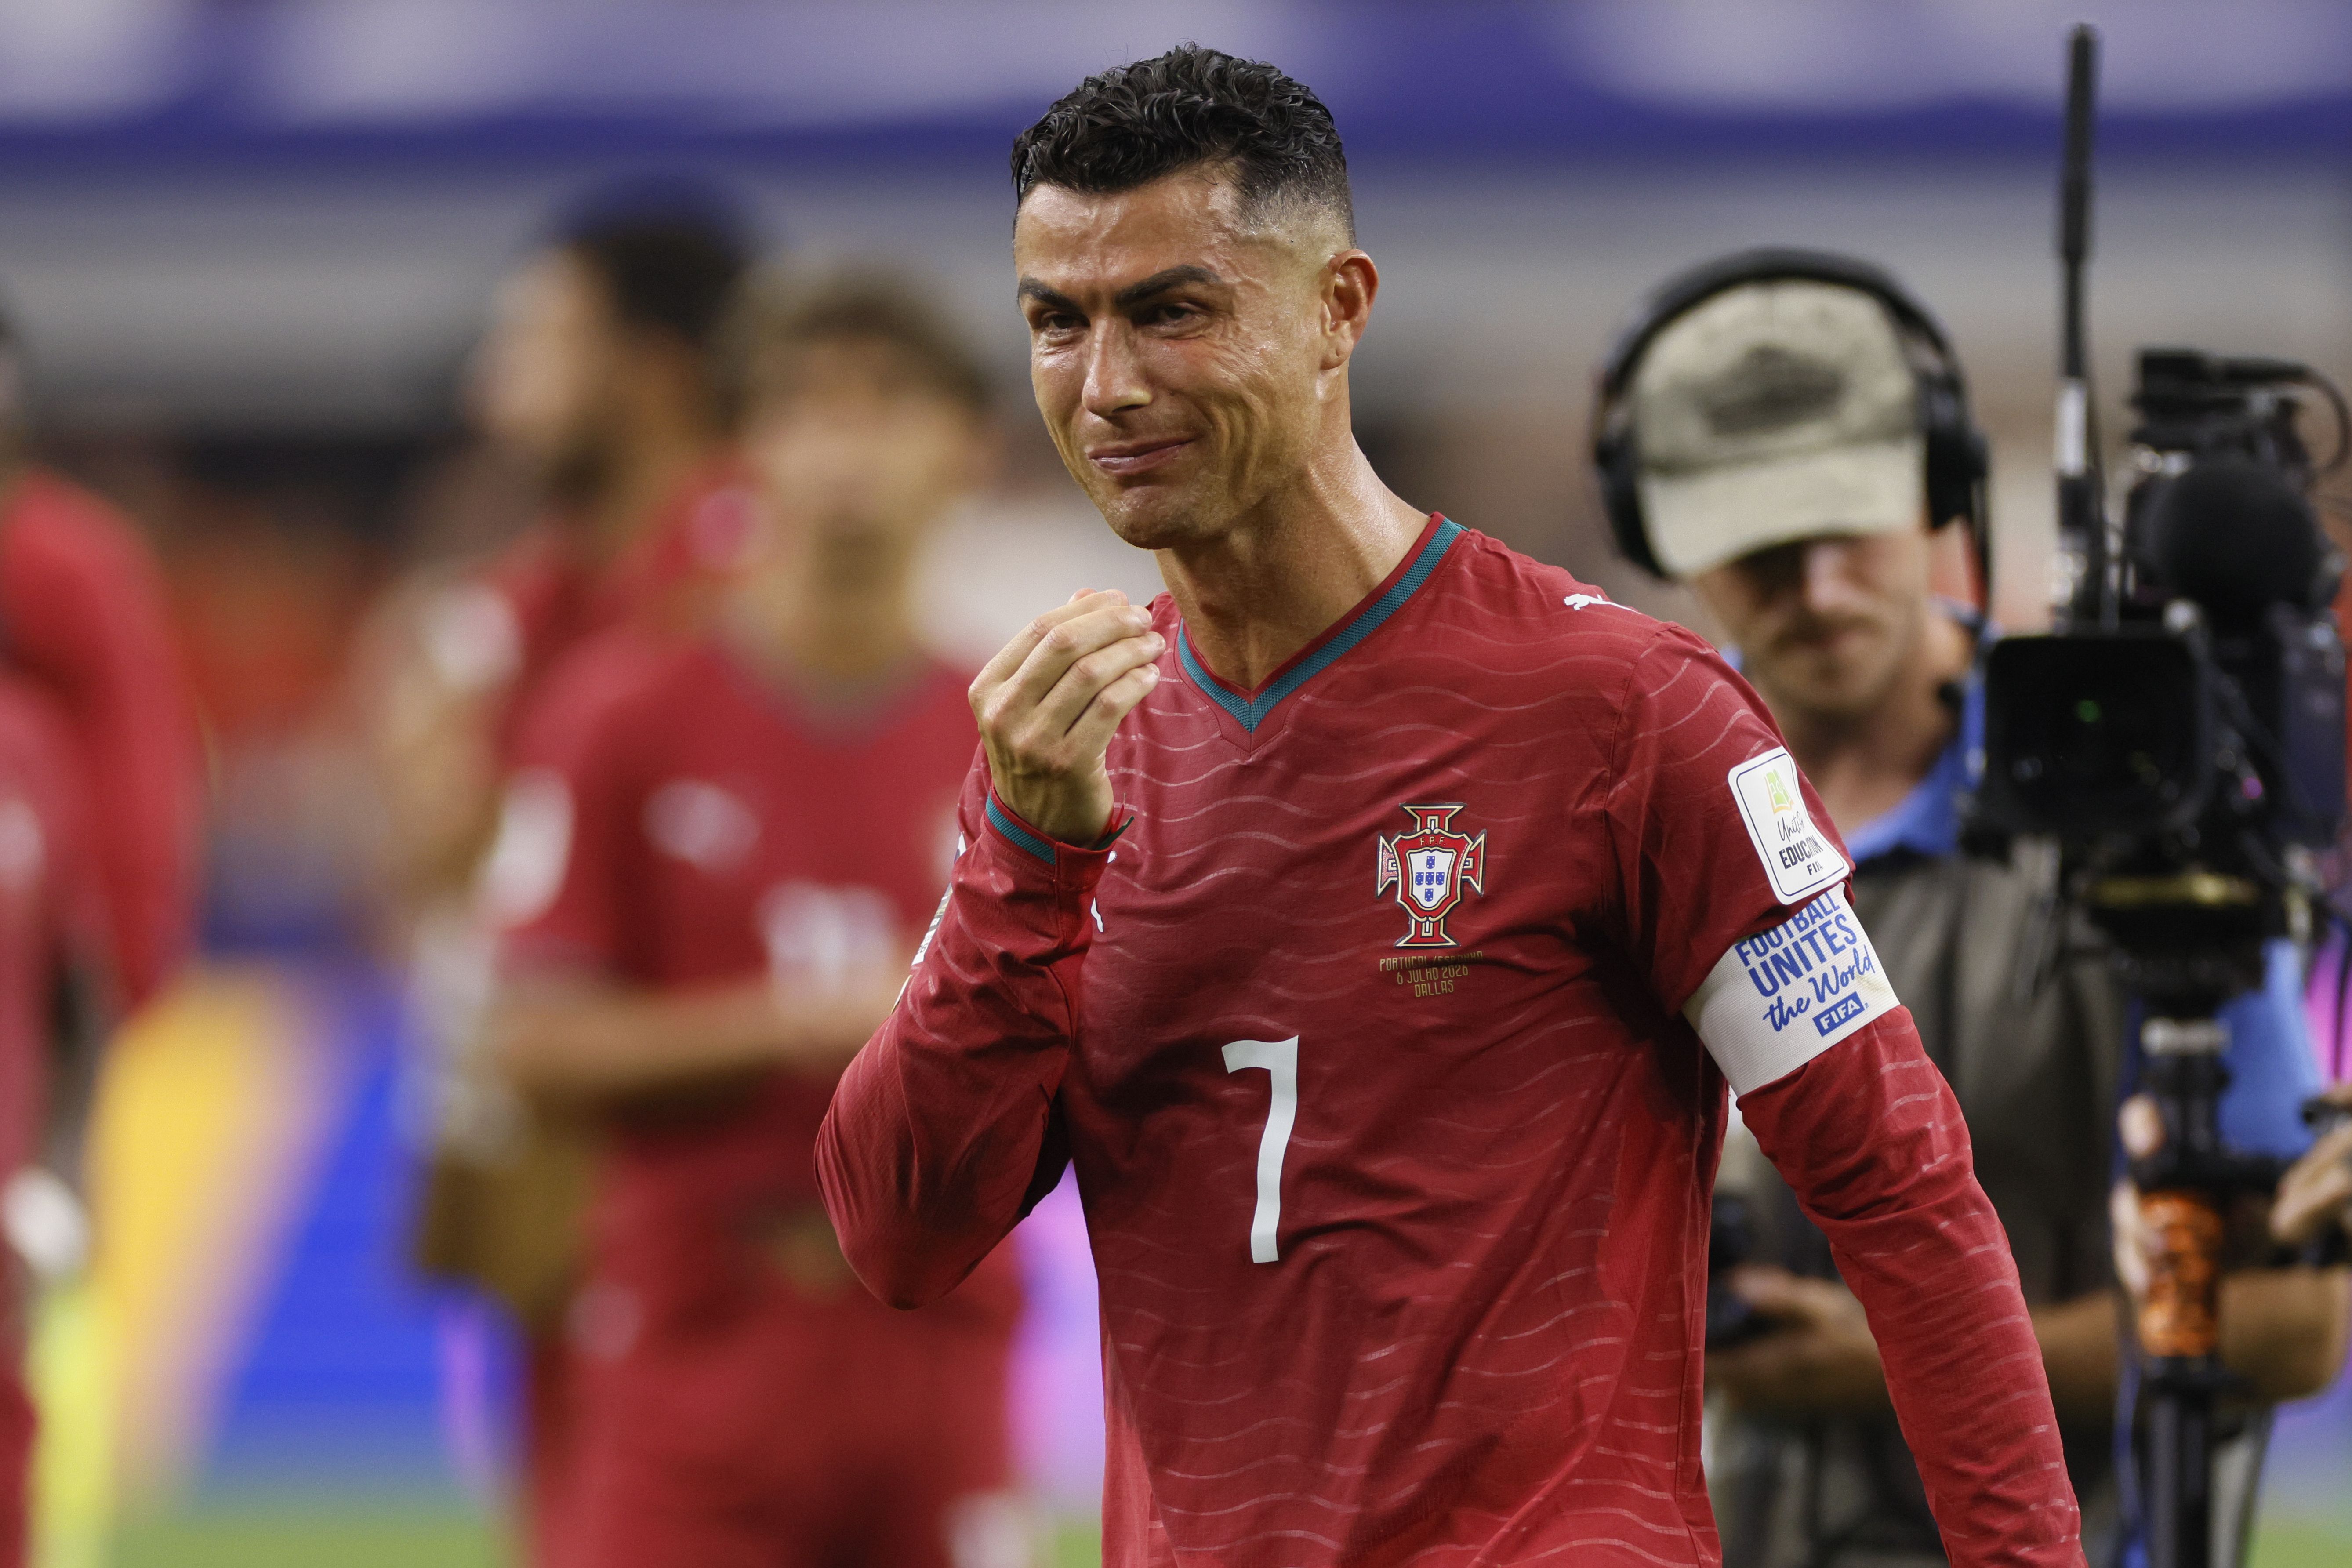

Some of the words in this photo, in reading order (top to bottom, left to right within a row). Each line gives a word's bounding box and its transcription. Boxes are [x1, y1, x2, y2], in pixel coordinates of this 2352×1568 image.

[1735, 892, 1840, 967] FOOTBALL
[1748, 913, 1857, 998] UNITES
[1397, 972, 1403, 985] 6
[1407, 967, 1438, 984] JULHO
[1441, 965, 1469, 979] 2026
[1414, 980, 1454, 998] DALLAS
[1762, 995, 1811, 1032] the
[1808, 944, 1876, 1003] World
[1819, 998, 1860, 1030] FIFA
[1221, 1035, 1299, 1263] 7
